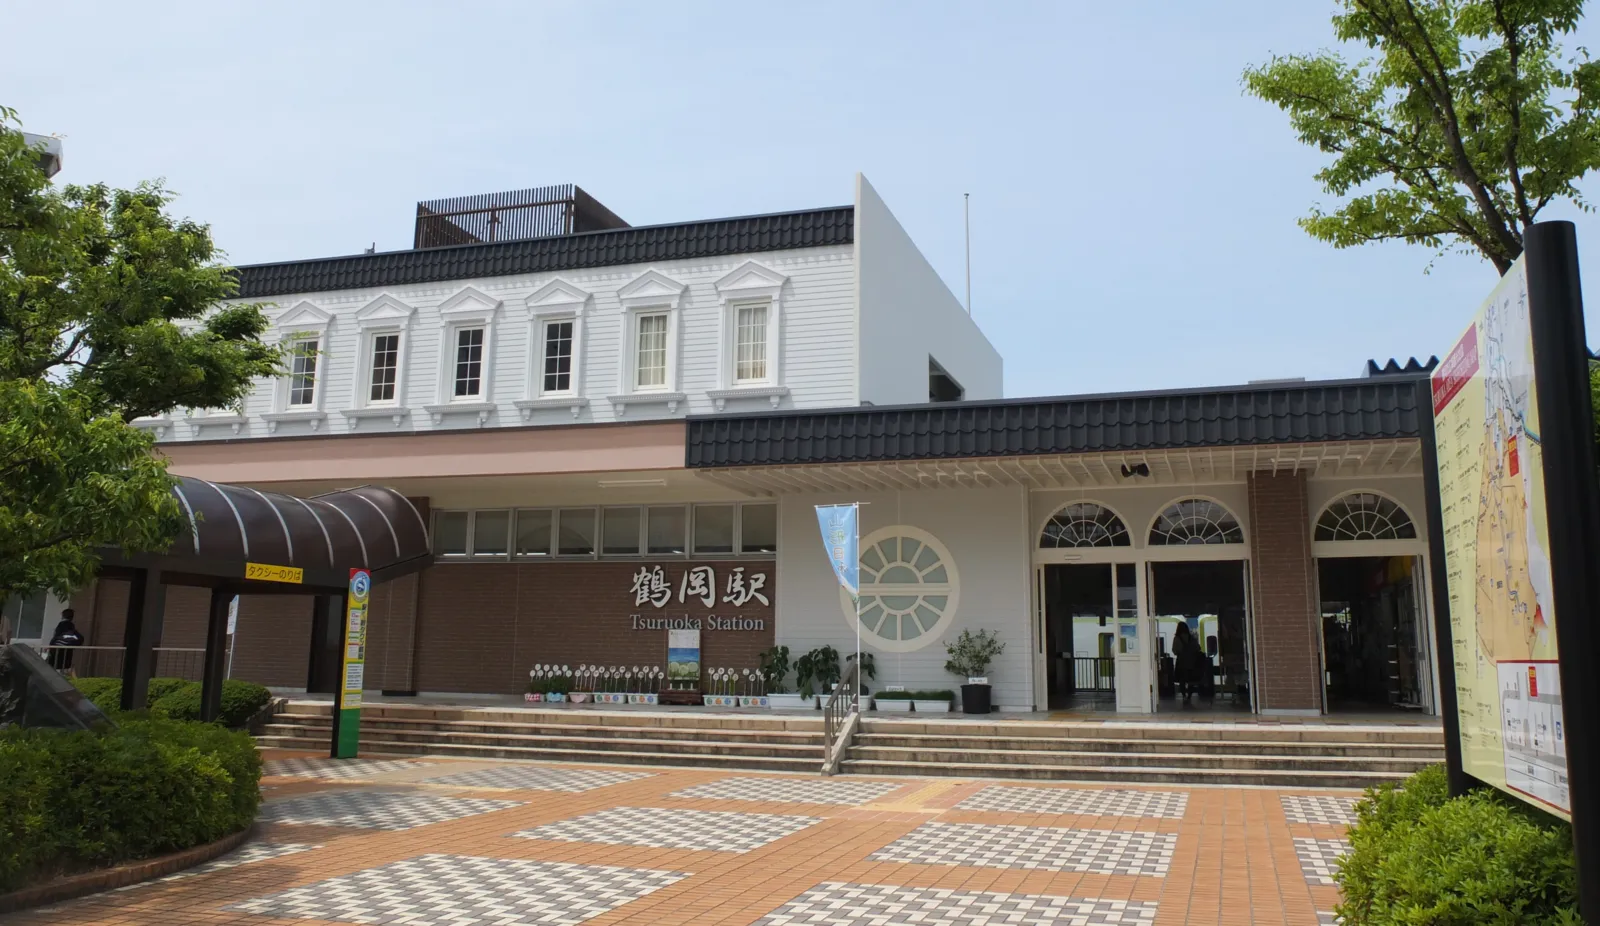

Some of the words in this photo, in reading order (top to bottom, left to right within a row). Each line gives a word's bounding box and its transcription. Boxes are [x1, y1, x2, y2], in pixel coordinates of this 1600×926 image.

[248, 566, 302, 581] タクシーのりば
[630, 565, 769, 608] 鶴岡駅
[630, 614, 702, 630] Tsuruoka
[707, 614, 764, 631] Station
